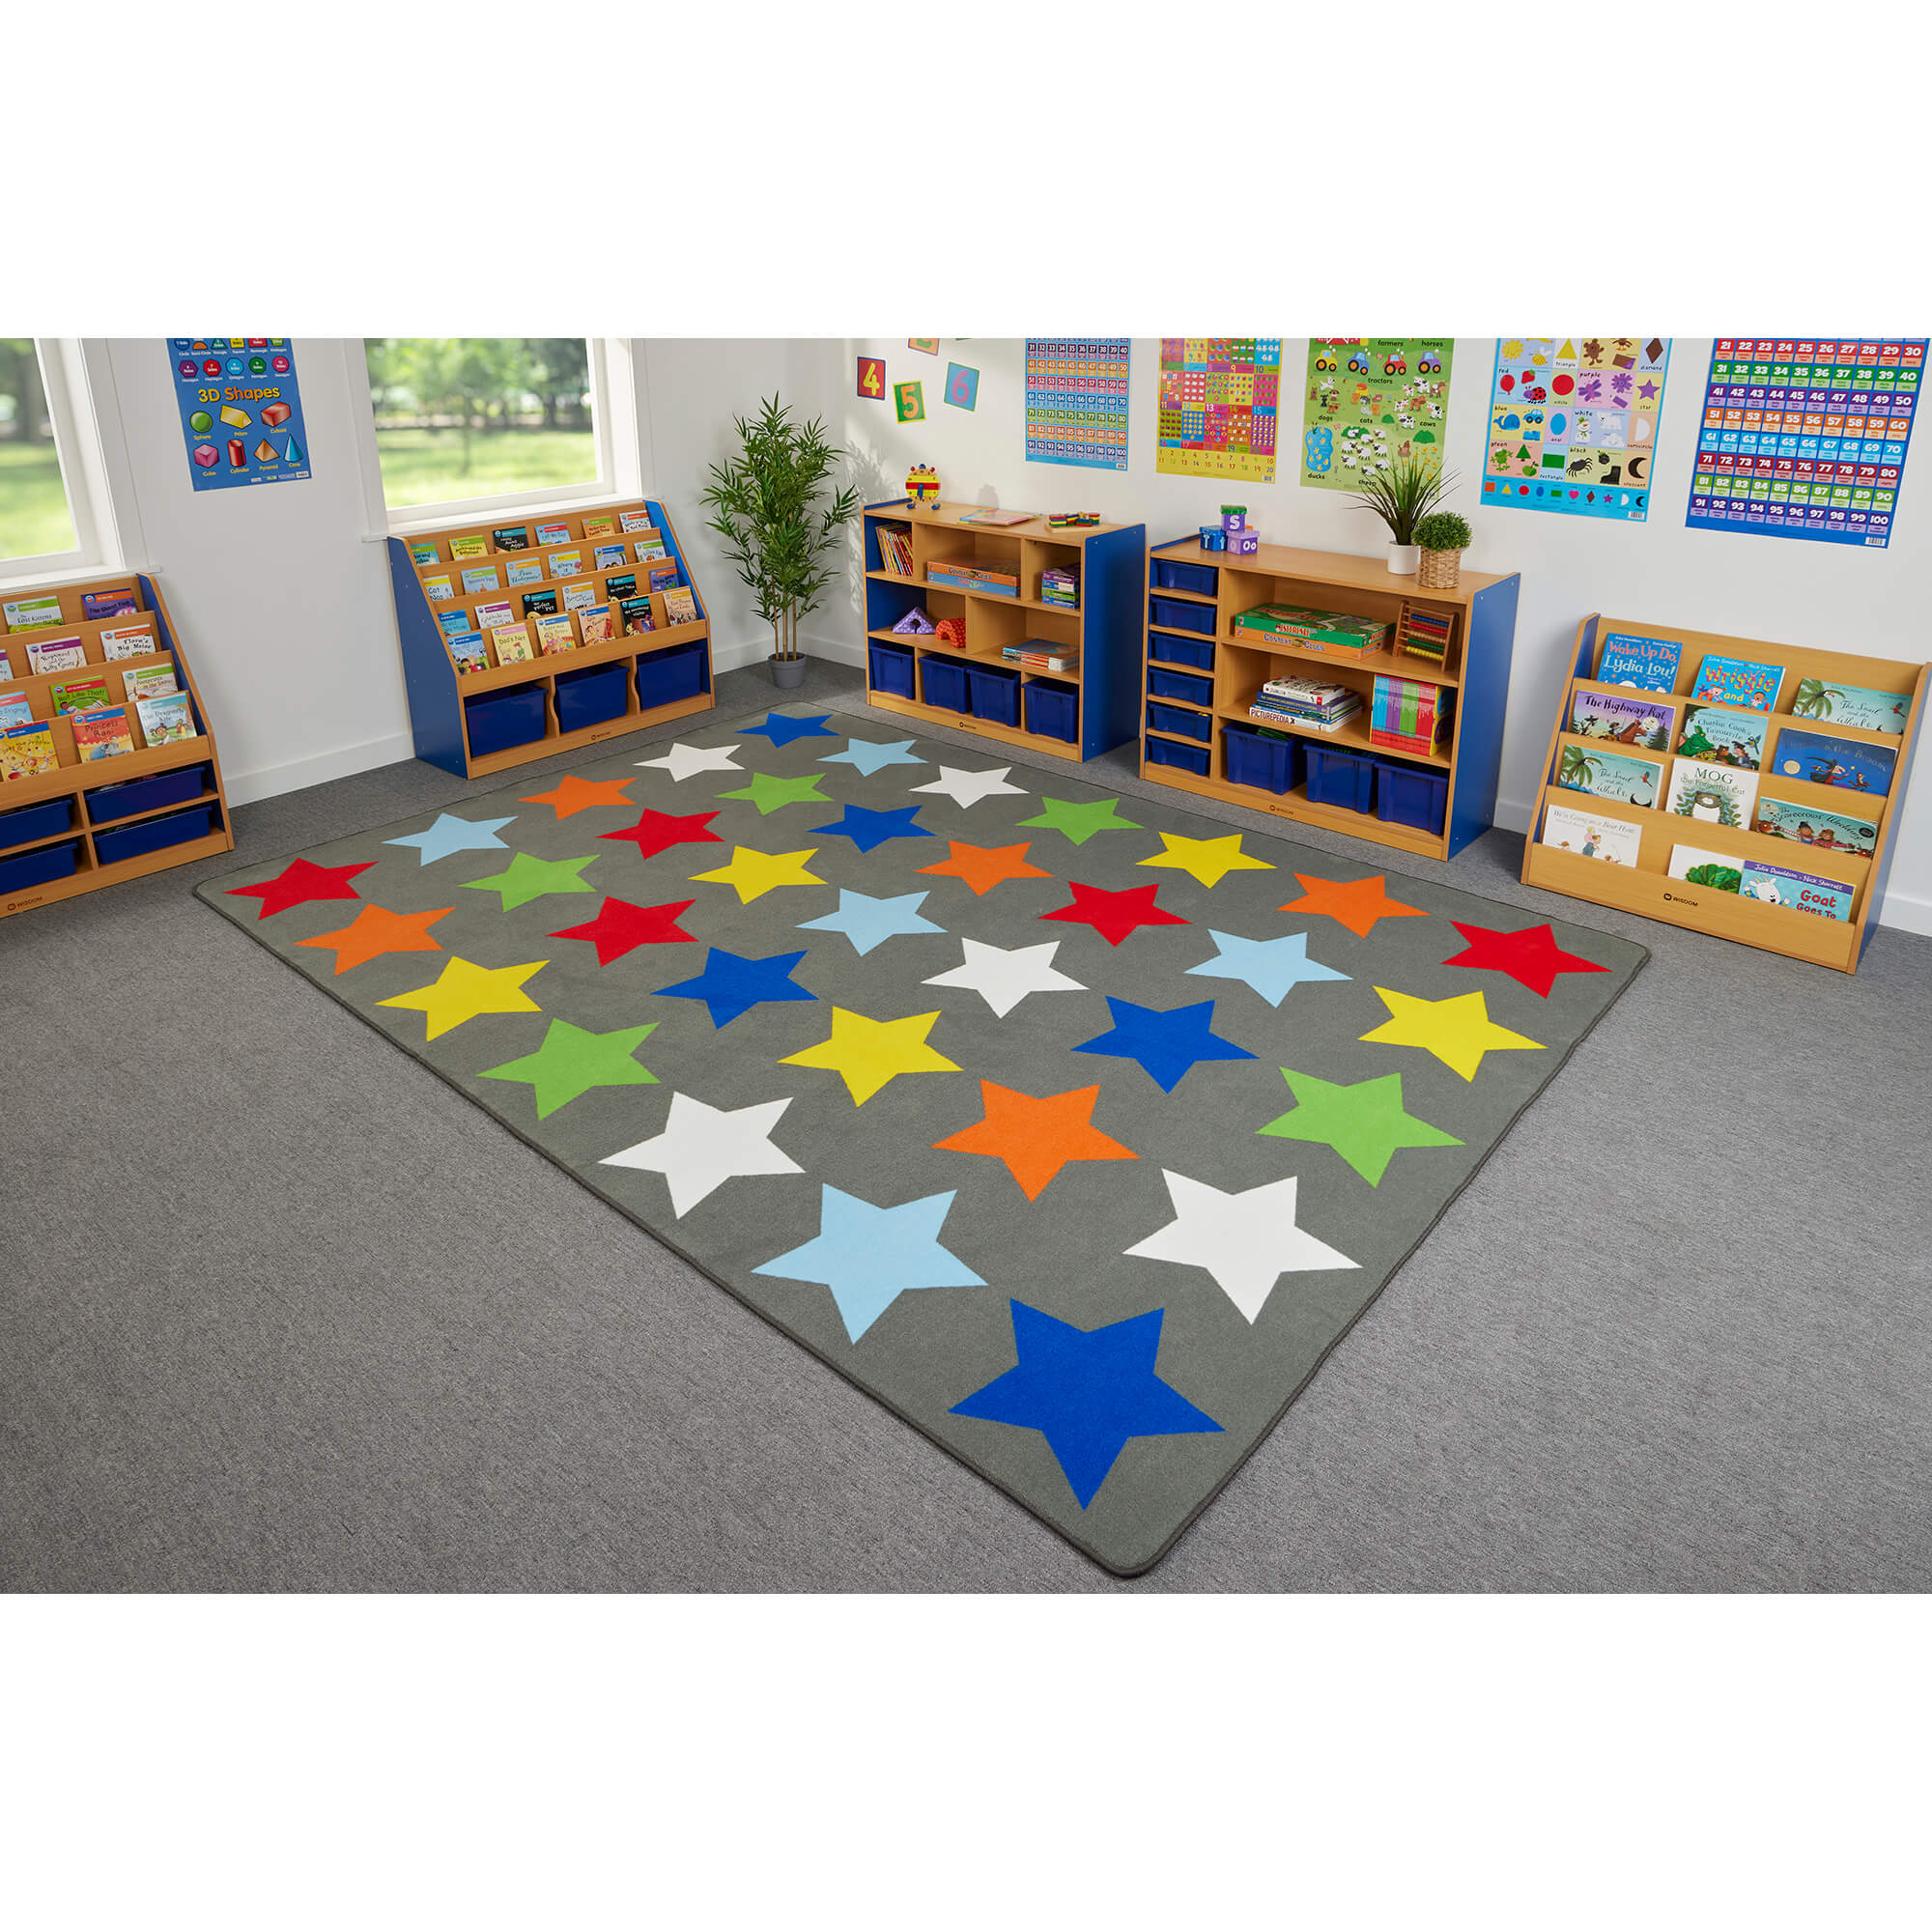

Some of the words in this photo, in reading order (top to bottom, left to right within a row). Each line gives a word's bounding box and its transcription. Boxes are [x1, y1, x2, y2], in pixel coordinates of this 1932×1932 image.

[1720, 341, 1731, 350] 21
[1738, 342, 1752, 351] 22
[1758, 342, 1773, 351] 23
[1777, 343, 1792, 352] 24
[1798, 343, 1813, 353] 25
[1819, 344, 1833, 353] 26
[1840, 345, 1856, 354] 27
[1861, 345, 1878, 355] 28
[1883, 346, 1899, 355] 29
[1905, 347, 1921, 356] 30
[1256, 365, 1264, 374] 10
[1717, 364, 1727, 373] 31
[1734, 365, 1748, 374] 32
[1774, 366, 1788, 375] 34
[1794, 367, 1808, 376] 35
[1814, 368, 1830, 377] 36
[1836, 369, 1851, 378] 37
[1857, 370, 1872, 379] 38
[1878, 371, 1894, 380] 39
[1900, 372, 1917, 381] 40
[863, 362, 880, 396] 4
[952, 370, 970, 404] 6
[197, 388, 221, 403] 3D
[224, 386, 281, 402] Shapes
[900, 384, 919, 418] 5
[1730, 388, 1745, 397] 42
[1749, 389, 1764, 398] 43
[1769, 390, 1784, 399] 44
[1789, 391, 1804, 400] 45
[1809, 392, 1825, 401] 46
[1832, 393, 1846, 402] 47
[1852, 394, 1867, 403] 48
[1873, 395, 1889, 404] 49
[1895, 396, 1912, 406] 50
[1206, 403, 1214, 412] 13
[1253, 406, 1263, 414] 15
[1710, 410, 1720, 418] 51
[1727, 411, 1741, 419] 52
[1747, 412, 1760, 421] 53
[1766, 413, 1780, 422] 54
[1785, 414, 1801, 423] 55
[1806, 415, 1821, 424] 56
[1828, 416, 1841, 425] 57
[1848, 418, 1863, 427] 58
[1869, 419, 1885, 428] 59
[1890, 420, 1907, 430] 60
[1706, 432, 1717, 440] 61
[1743, 435, 1756, 443] 63
[1782, 438, 1796, 446] 65
[1843, 441, 1859, 450] 68
[1720, 456, 1733, 465] 72
[1759, 459, 1771, 468] 74
[1778, 461, 1791, 469] 75
[1799, 462, 1811, 470] 76
[1819, 464, 1833, 472] 77
[1839, 466, 1854, 474] 78
[1861, 467, 1875, 475] 79
[1881, 469, 1897, 477] 80
[1716, 478, 1730, 487] 82
[1735, 480, 1748, 489] 83
[1753, 481, 1768, 490] 84
[1774, 483, 1788, 492] 85
[1793, 485, 1807, 494] 86
[1814, 487, 1829, 496] 87
[1834, 489, 1849, 497] 88
[1876, 492, 1892, 501] 90
[1229, 515, 1240, 530] S
[1770, 505, 1783, 515] 95
[1789, 507, 1804, 517] 96
[1810, 509, 1824, 518] 97
[1830, 511, 1845, 521] 98
[1851, 513, 1866, 522] 99
[1870, 515, 1889, 525] 100
[1609, 640, 1639, 656] Wake
[1640, 645, 1658, 661] Up
[1604, 655, 1643, 673] Lydia
[1646, 663, 1676, 677] Lou!
[1706, 666, 1776, 695] Wriggle
[57, 694, 71, 702] Not
[1723, 693, 1744, 703] and
[1251, 708, 1290, 724] PICTUREPEDIA
[1584, 696, 1602, 707] The
[1604, 698, 1646, 718] Highway
[1647, 707, 1666, 720] Rat
[1694, 767, 1733, 784] MOG
[1803, 874, 1818, 883] Nick
[1801, 890, 1836, 908] Goat
[1796, 902, 1823, 915] Goes
[1823, 910, 1836, 920] To
